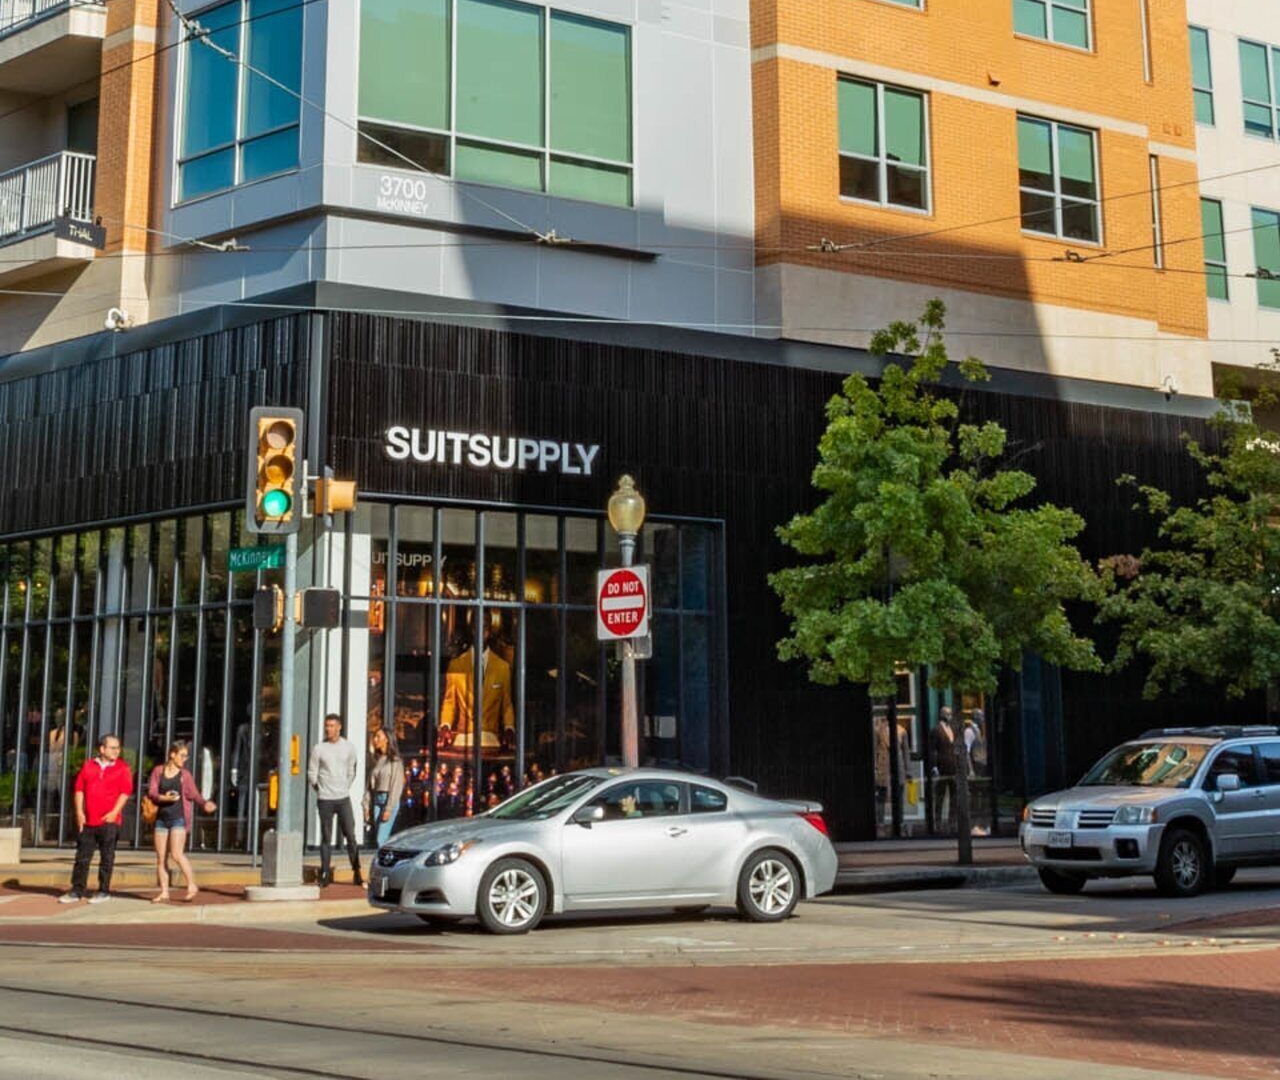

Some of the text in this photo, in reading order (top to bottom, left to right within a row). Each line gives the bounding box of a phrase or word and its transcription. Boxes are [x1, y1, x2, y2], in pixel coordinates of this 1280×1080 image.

[380, 175, 426, 201] 3700
[386, 426, 600, 475] SUITSUPPLY
[607, 581, 640, 595] DO NOT
[607, 611, 639, 625] ENTER
